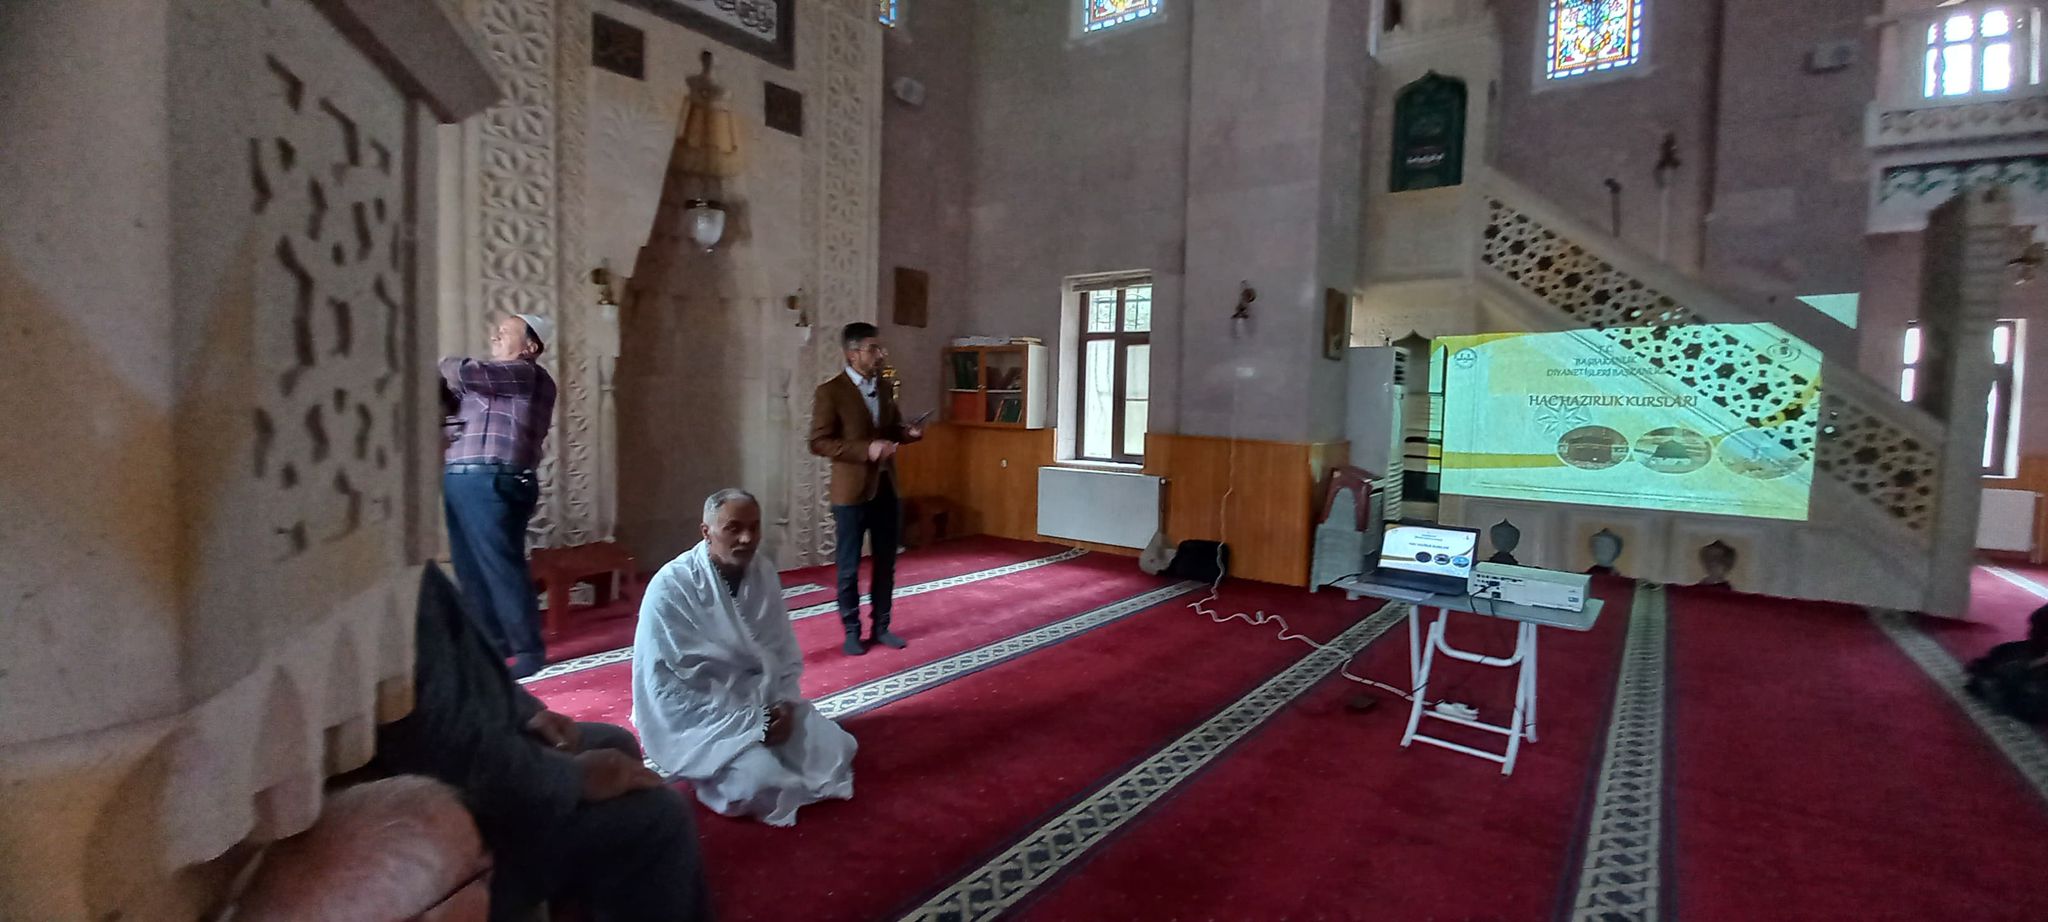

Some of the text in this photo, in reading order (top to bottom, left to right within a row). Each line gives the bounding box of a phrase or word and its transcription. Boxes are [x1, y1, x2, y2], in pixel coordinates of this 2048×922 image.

[1529, 394, 1698, 408] HAC HAZIRLIK KURSLARI
